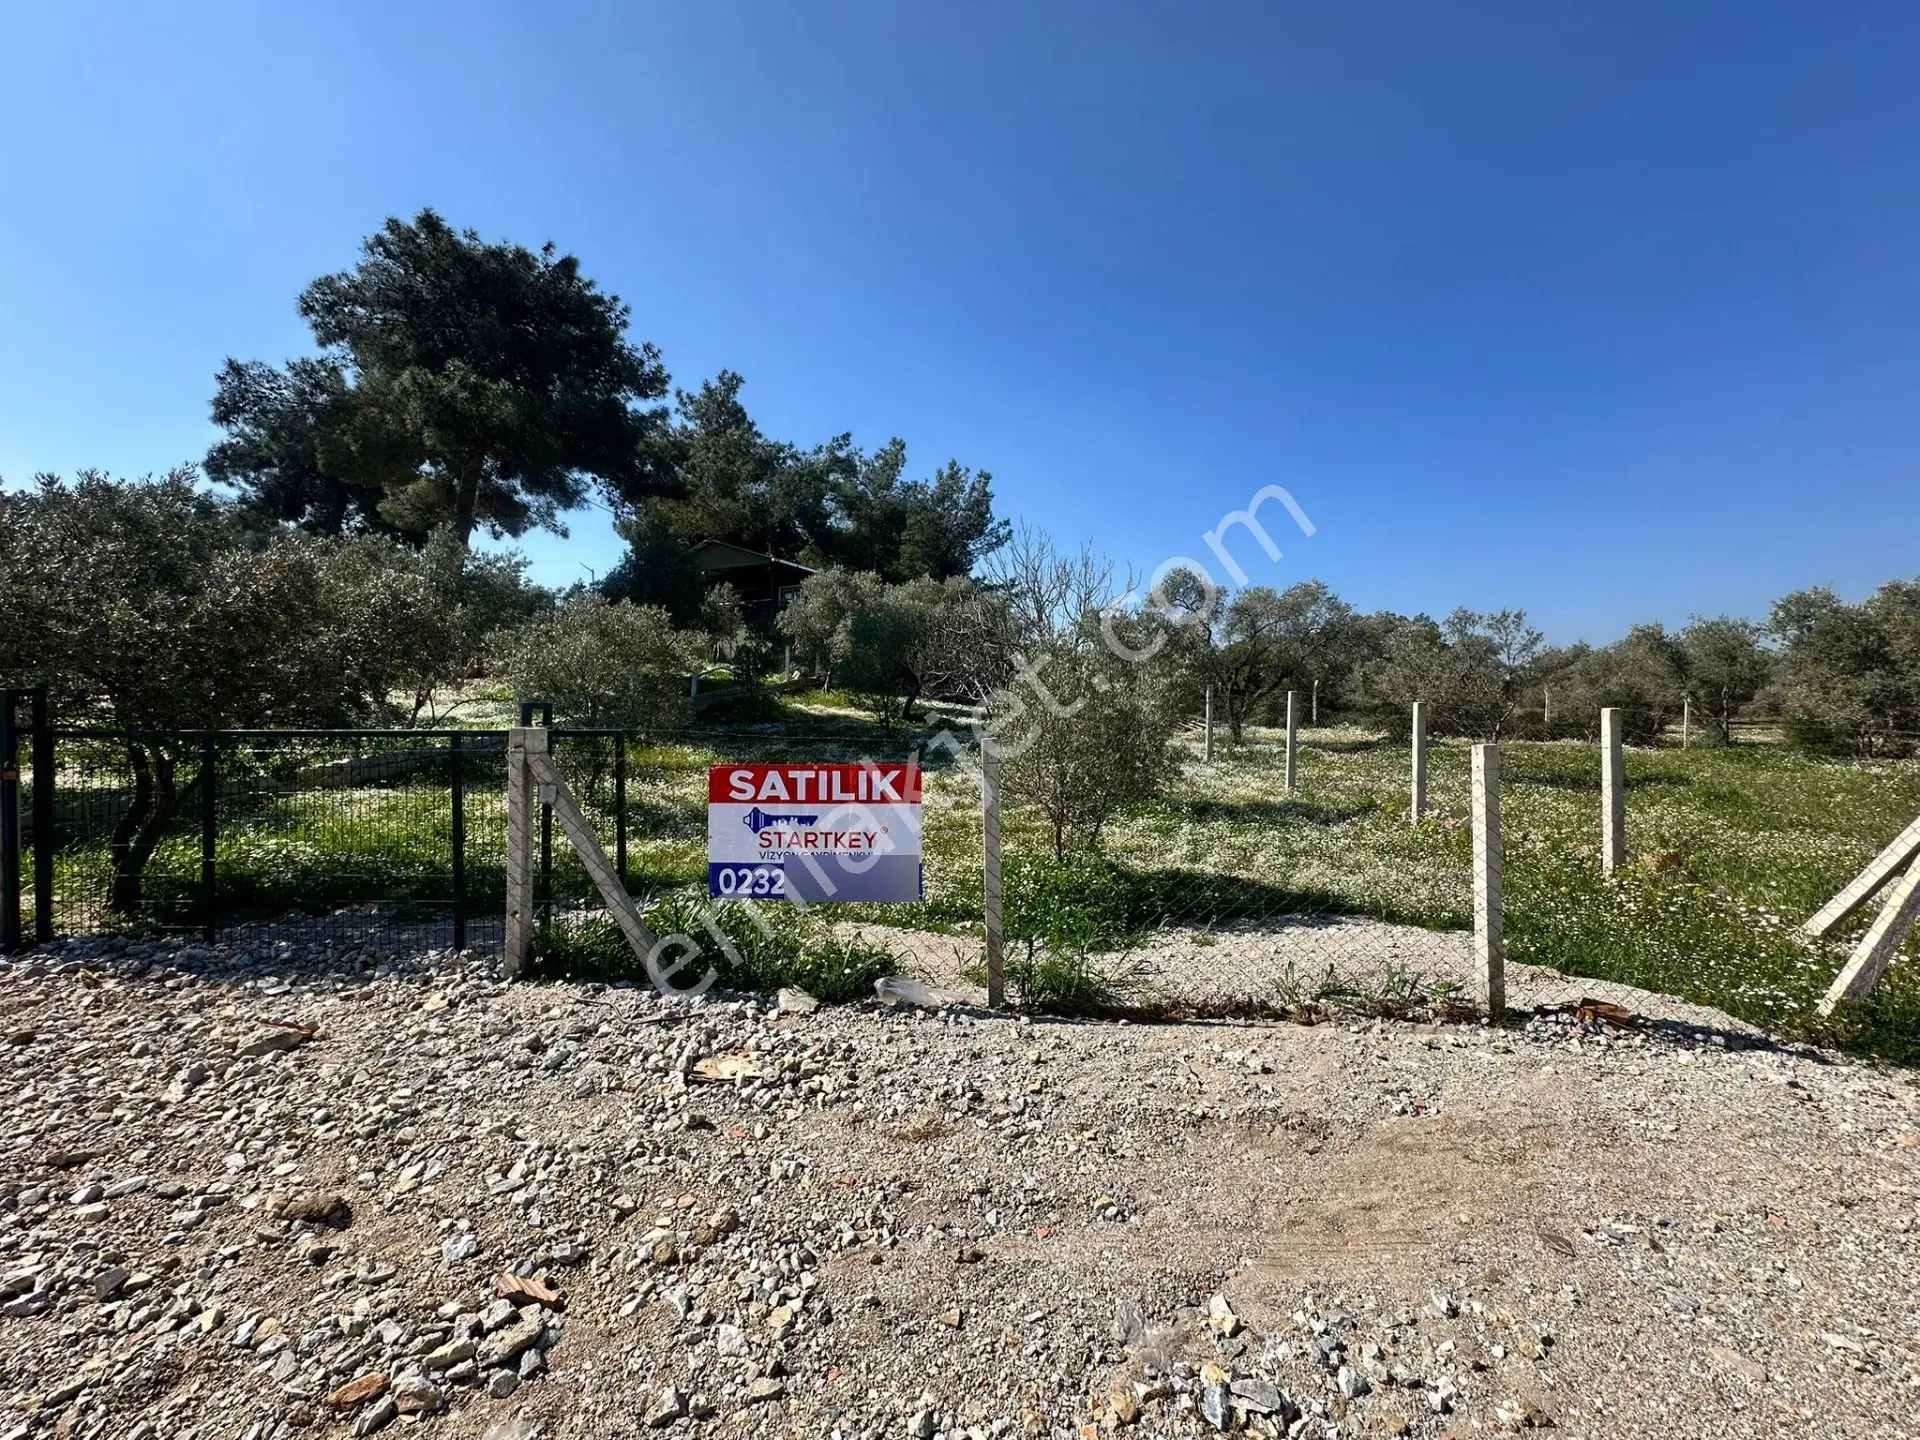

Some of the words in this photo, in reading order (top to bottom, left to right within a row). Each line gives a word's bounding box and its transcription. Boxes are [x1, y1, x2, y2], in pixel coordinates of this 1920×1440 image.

[728, 769, 903, 801] SATILIK
[759, 831, 878, 848] STARTKEY
[718, 868, 784, 895] 0232
